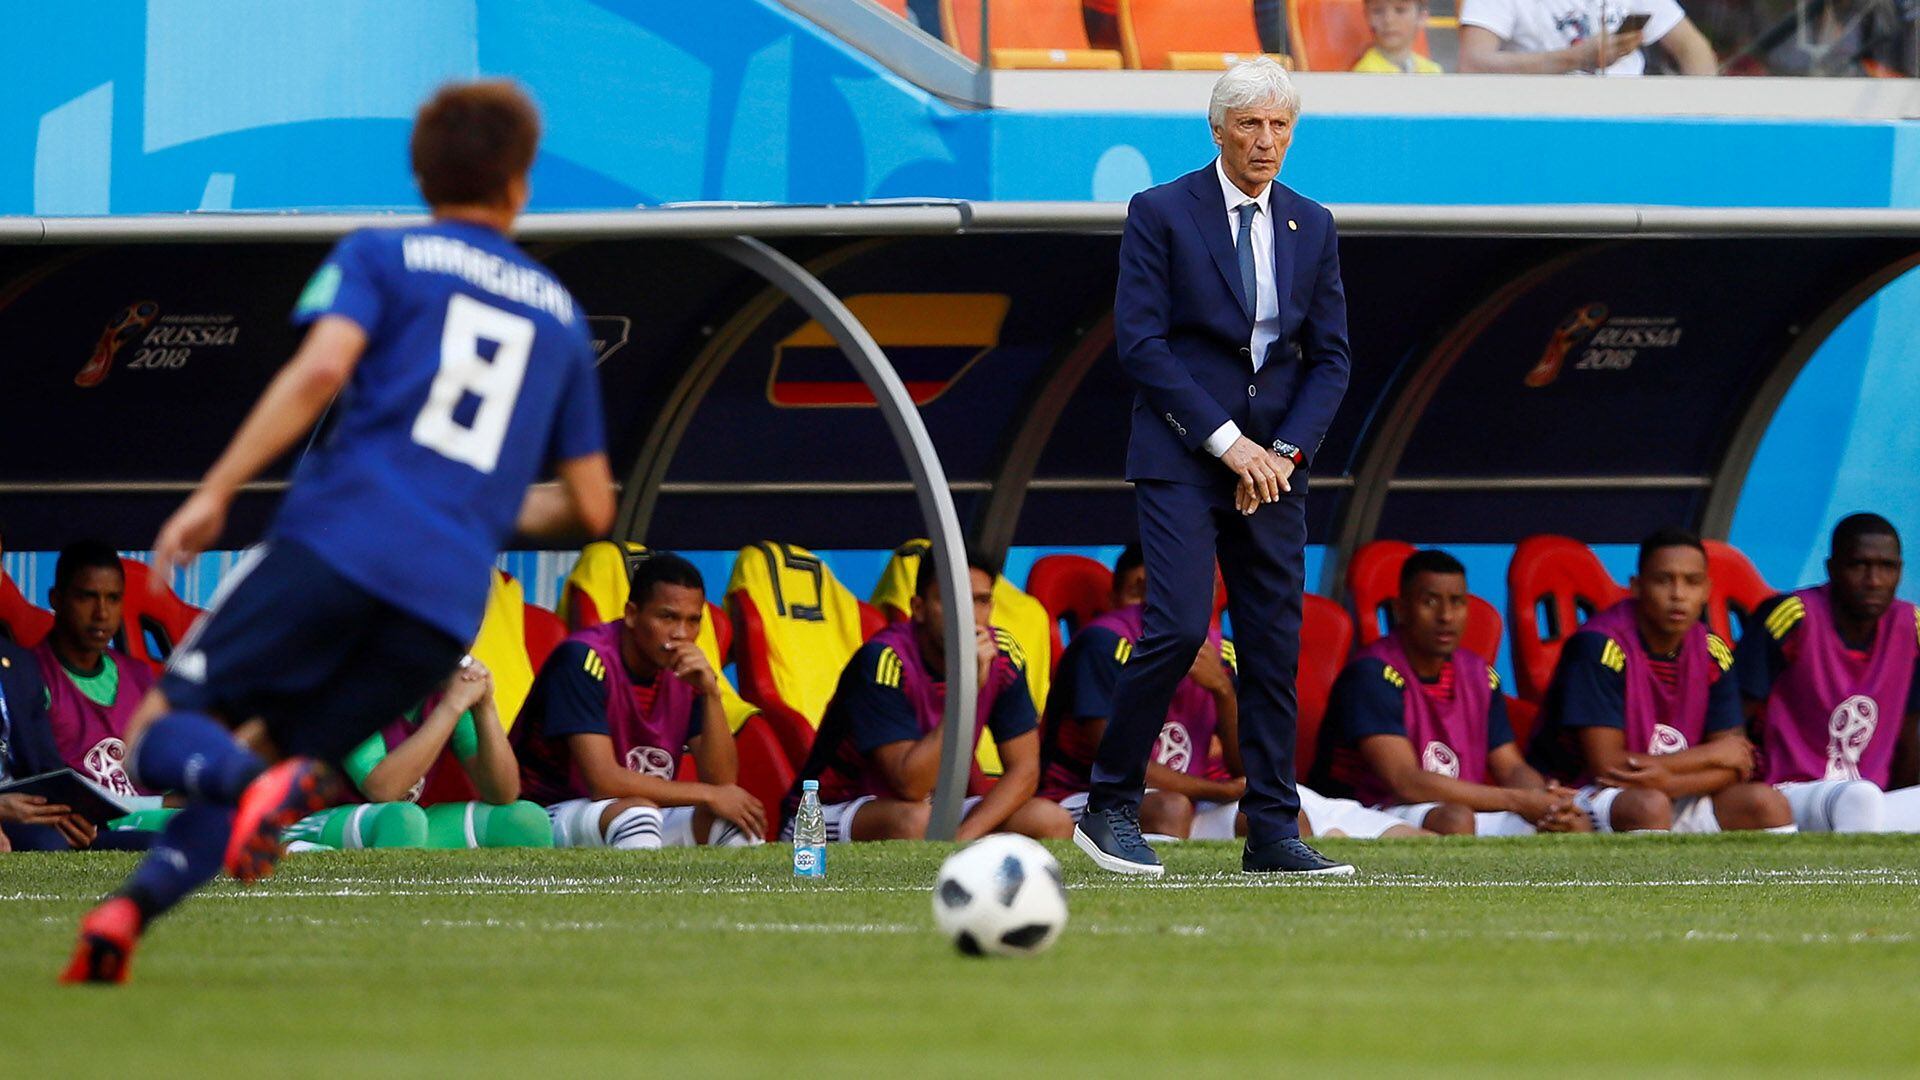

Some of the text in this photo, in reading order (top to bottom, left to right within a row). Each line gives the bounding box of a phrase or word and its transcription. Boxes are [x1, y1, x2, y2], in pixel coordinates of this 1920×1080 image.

[127, 348, 191, 369] 2018
[143, 325, 239, 346] RUSSIA
[411, 292, 537, 474] 8
[758, 542, 824, 622] 15
